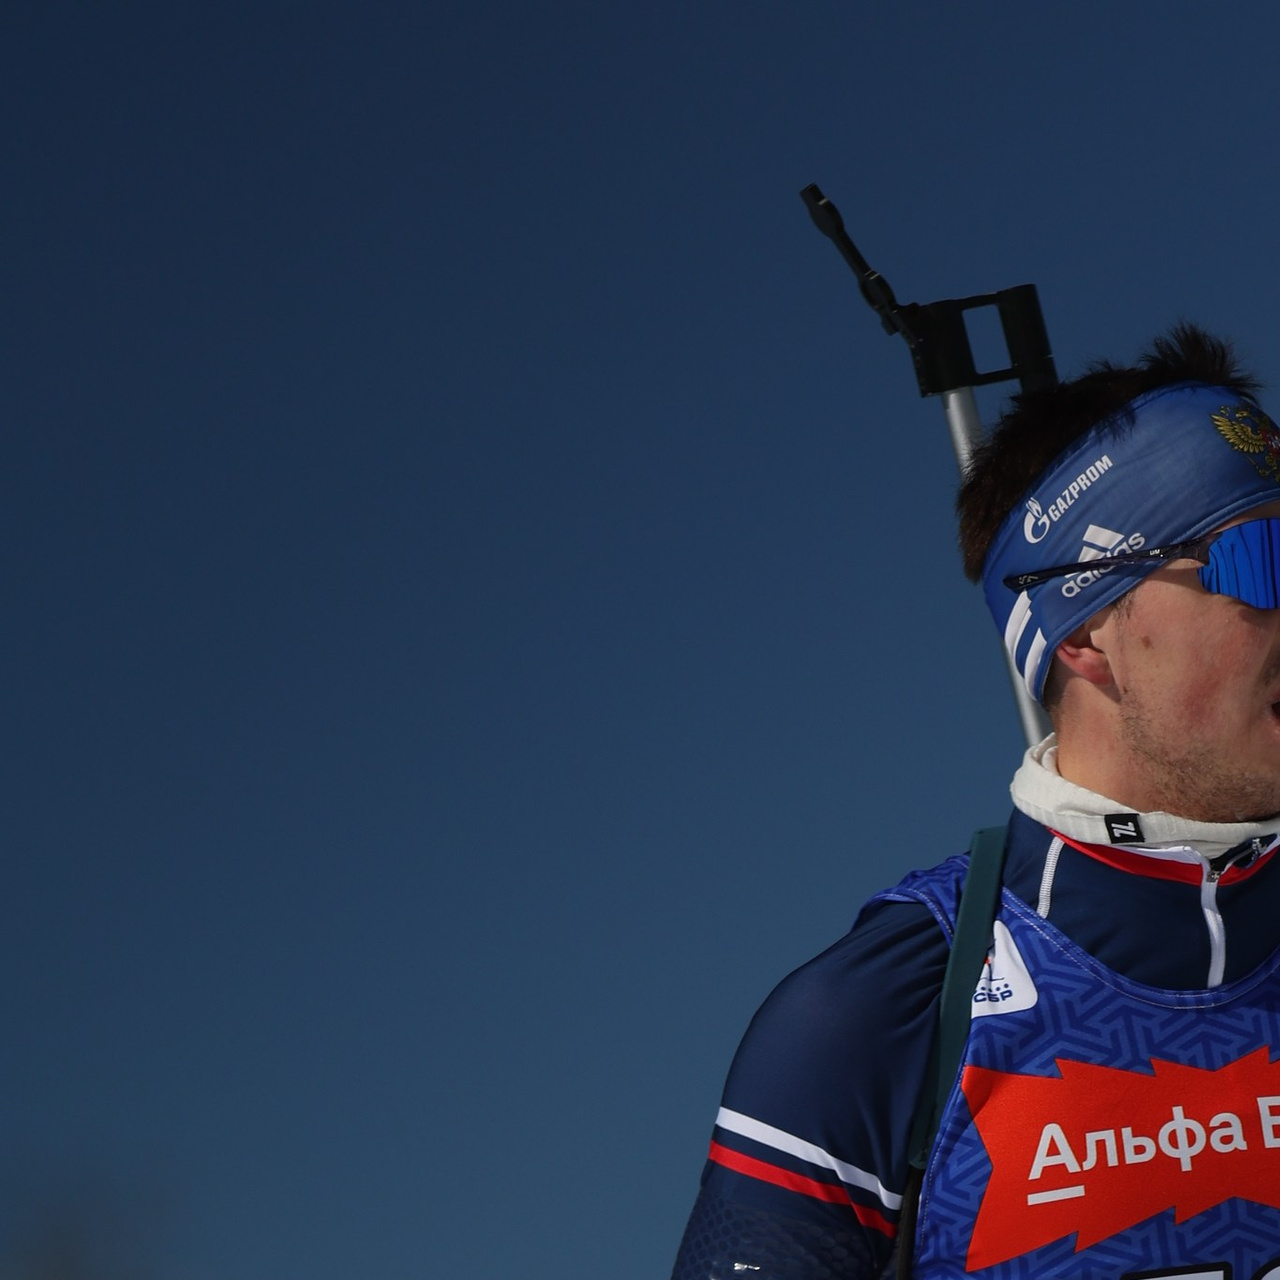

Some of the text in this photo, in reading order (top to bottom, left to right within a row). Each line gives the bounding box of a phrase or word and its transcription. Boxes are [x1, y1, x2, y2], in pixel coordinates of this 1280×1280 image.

[1048, 455, 1113, 522] GAZPROM
[1061, 532, 1146, 598] adas
[1027, 1106, 1248, 1181] Альфа
